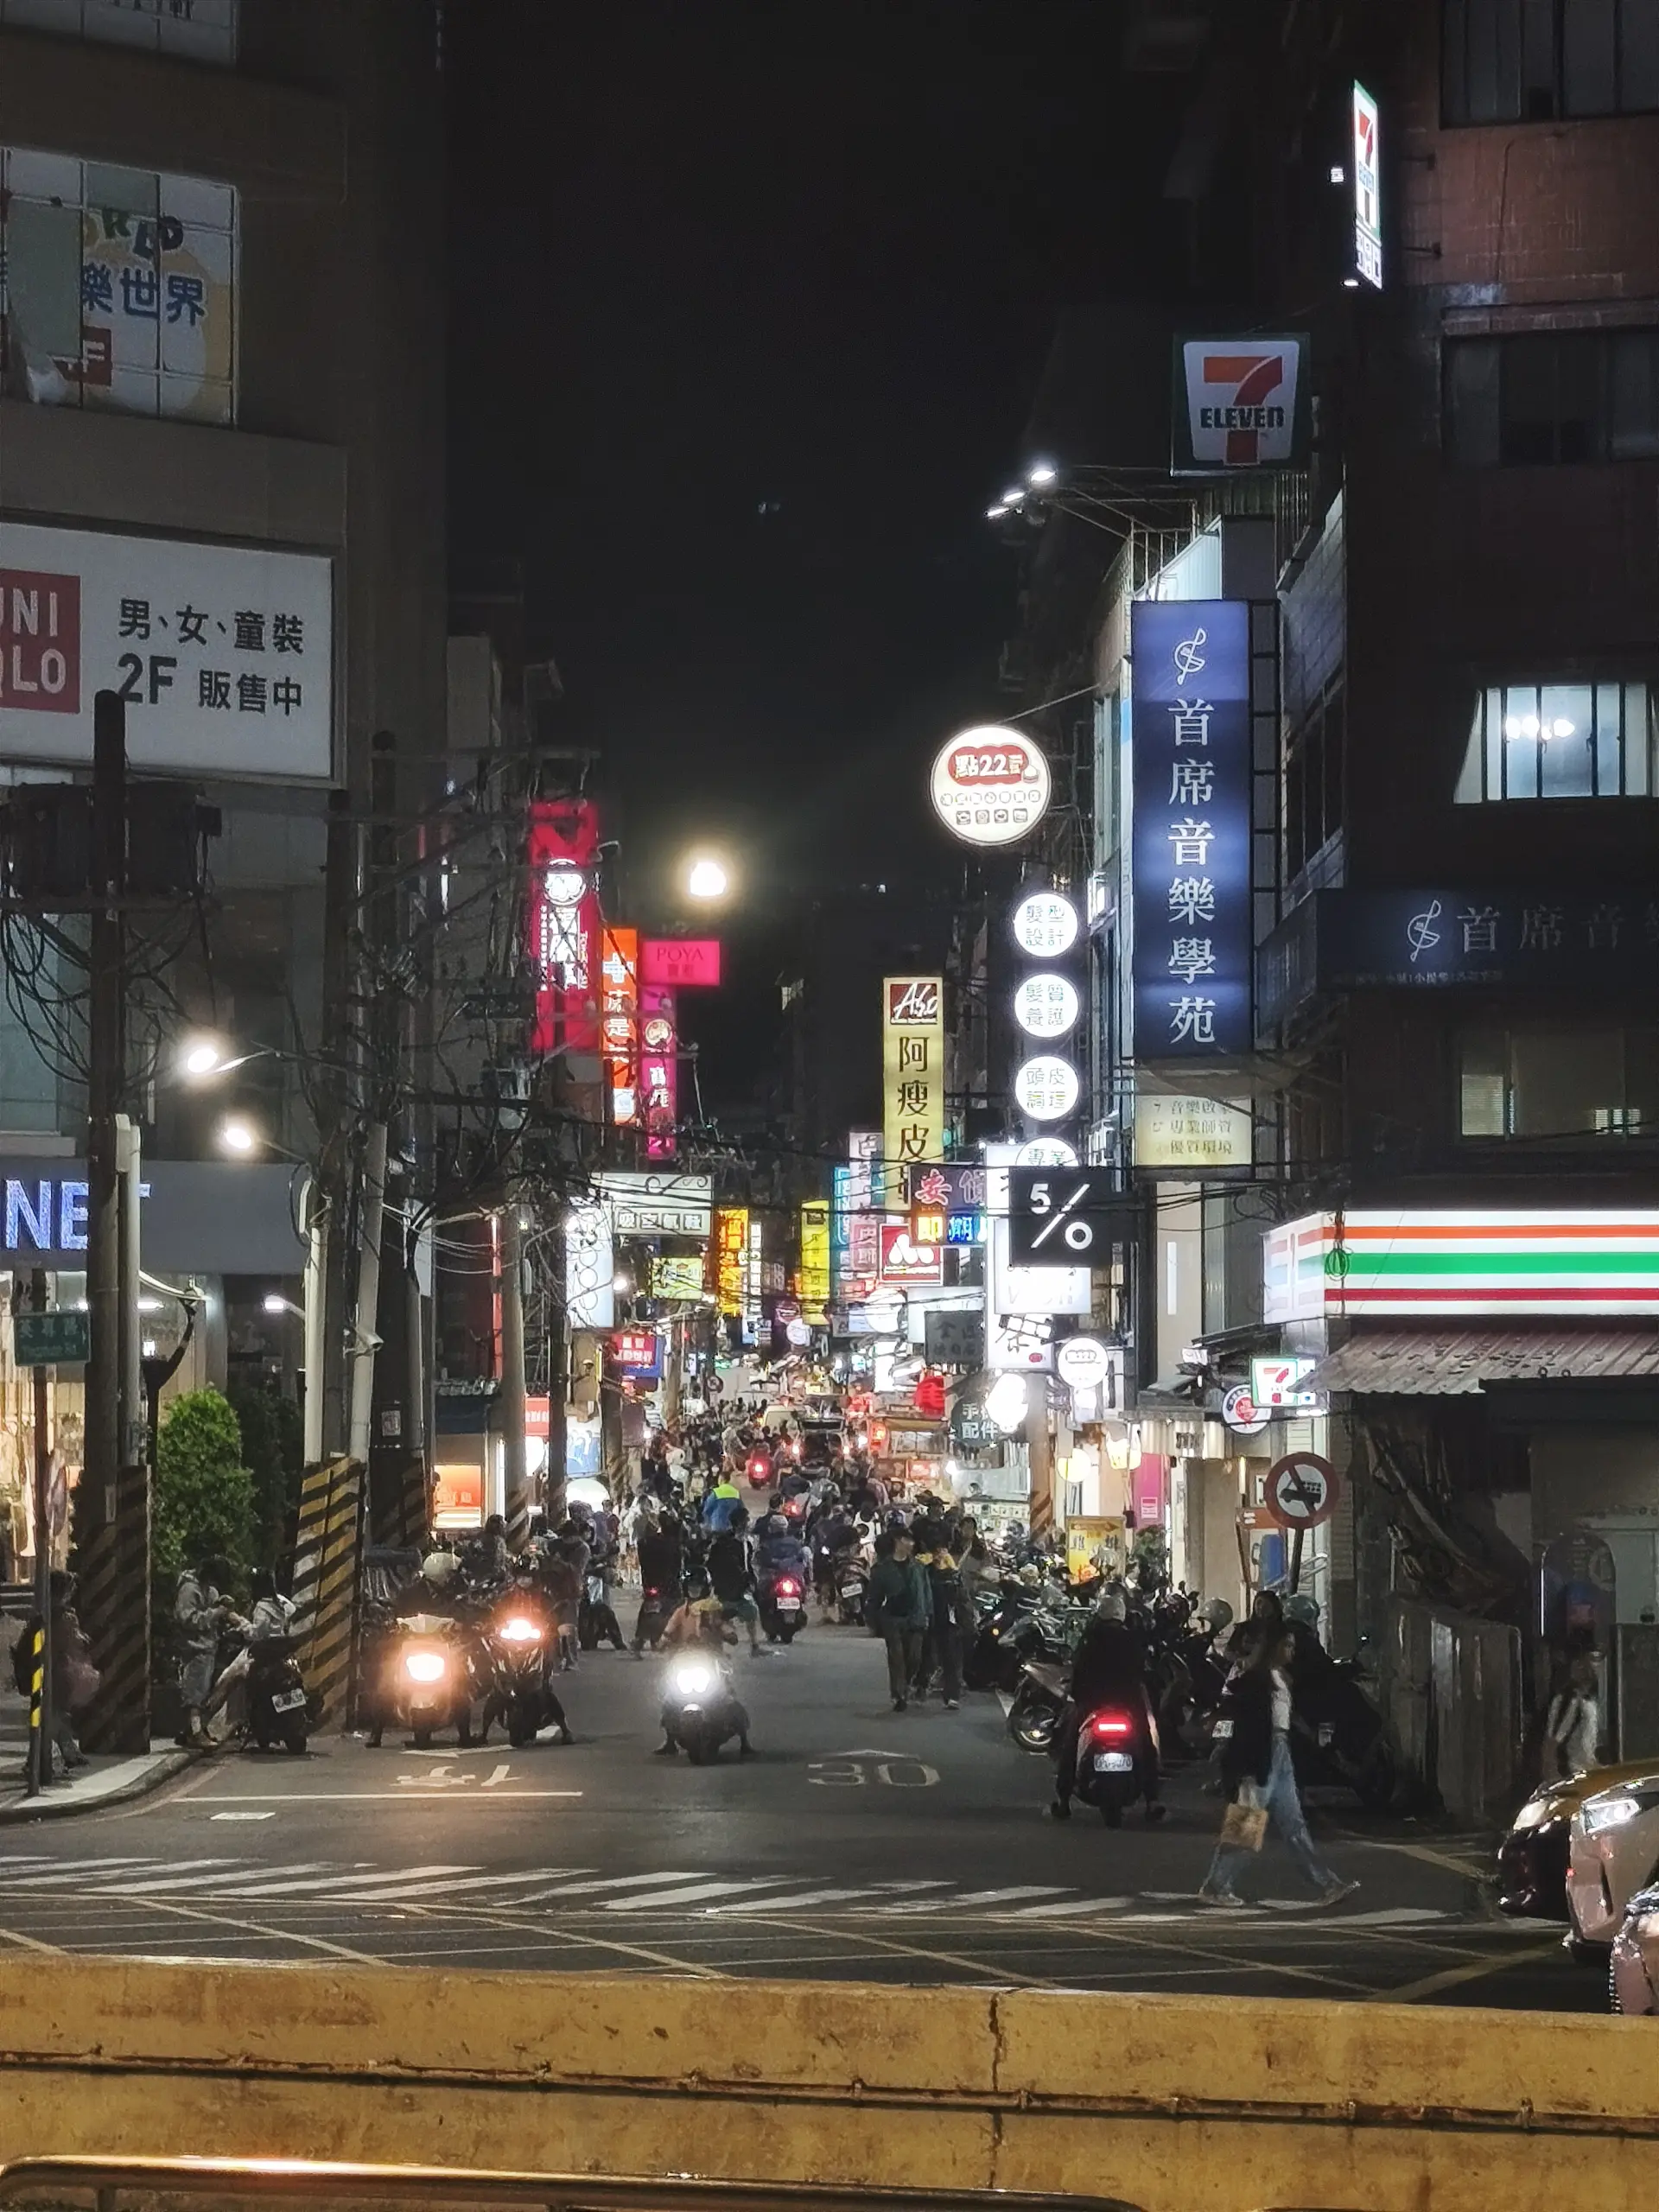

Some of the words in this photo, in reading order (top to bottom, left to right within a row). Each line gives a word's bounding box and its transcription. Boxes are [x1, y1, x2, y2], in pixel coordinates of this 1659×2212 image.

[0, 586, 59, 638] NI
[118, 598, 305, 656] 男、女、童裝
[0, 644, 67, 695] LO
[117, 652, 178, 704] 2F
[198, 669, 302, 716] 販售中
[1166, 698, 1217, 1044] 首席音樂學苑
[657, 946, 704, 963] POYA
[1456, 905, 1659, 954] 首席音
[5, 1178, 151, 1250] NE
[808, 1762, 941, 1787] 30
